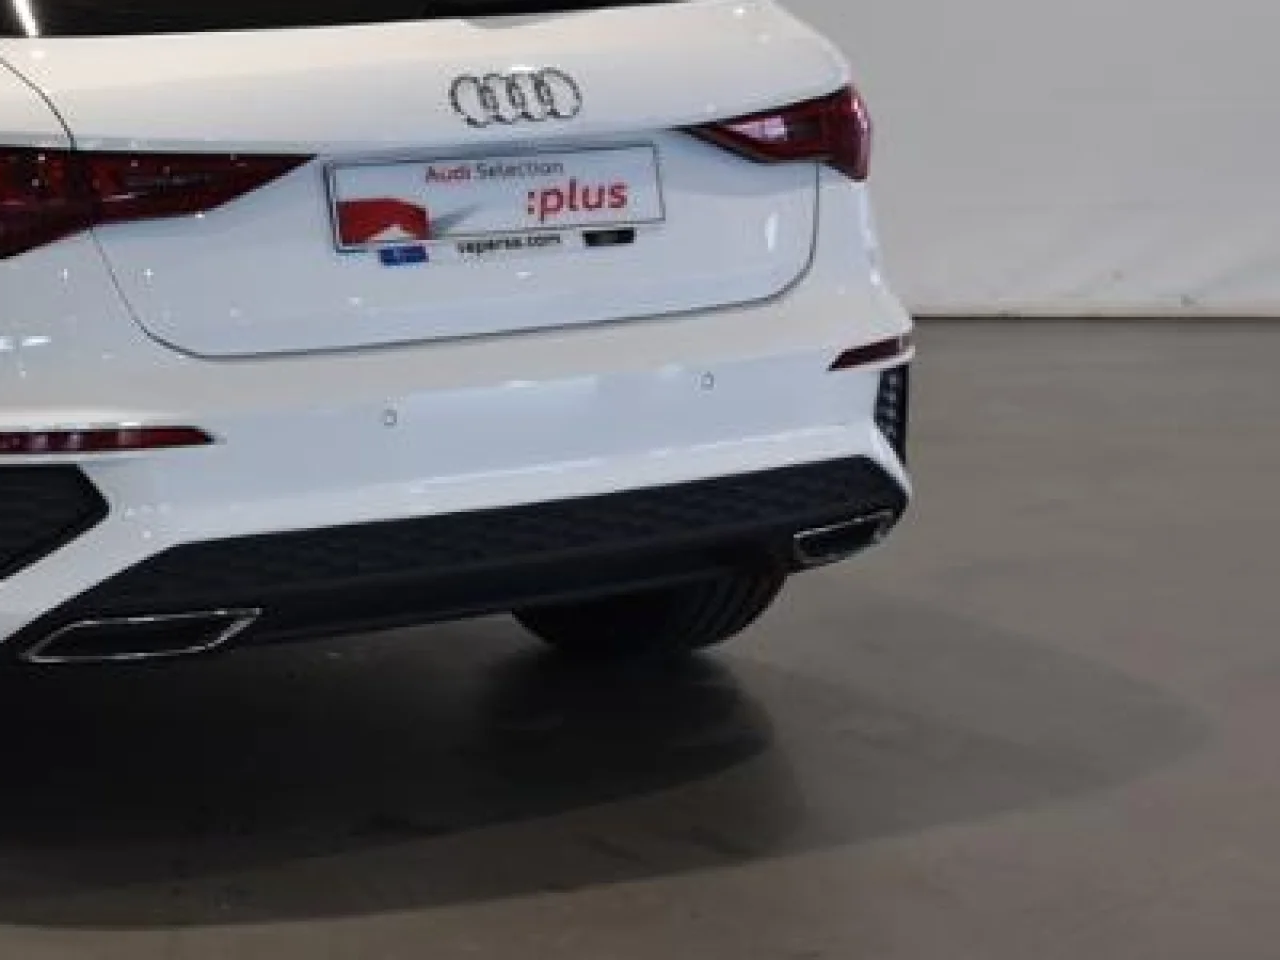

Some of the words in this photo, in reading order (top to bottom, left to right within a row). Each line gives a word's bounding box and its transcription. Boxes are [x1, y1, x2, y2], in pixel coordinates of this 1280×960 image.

[425, 164, 471, 184] Audi
[475, 161, 564, 179] Selection
[526, 176, 628, 222] :plus
